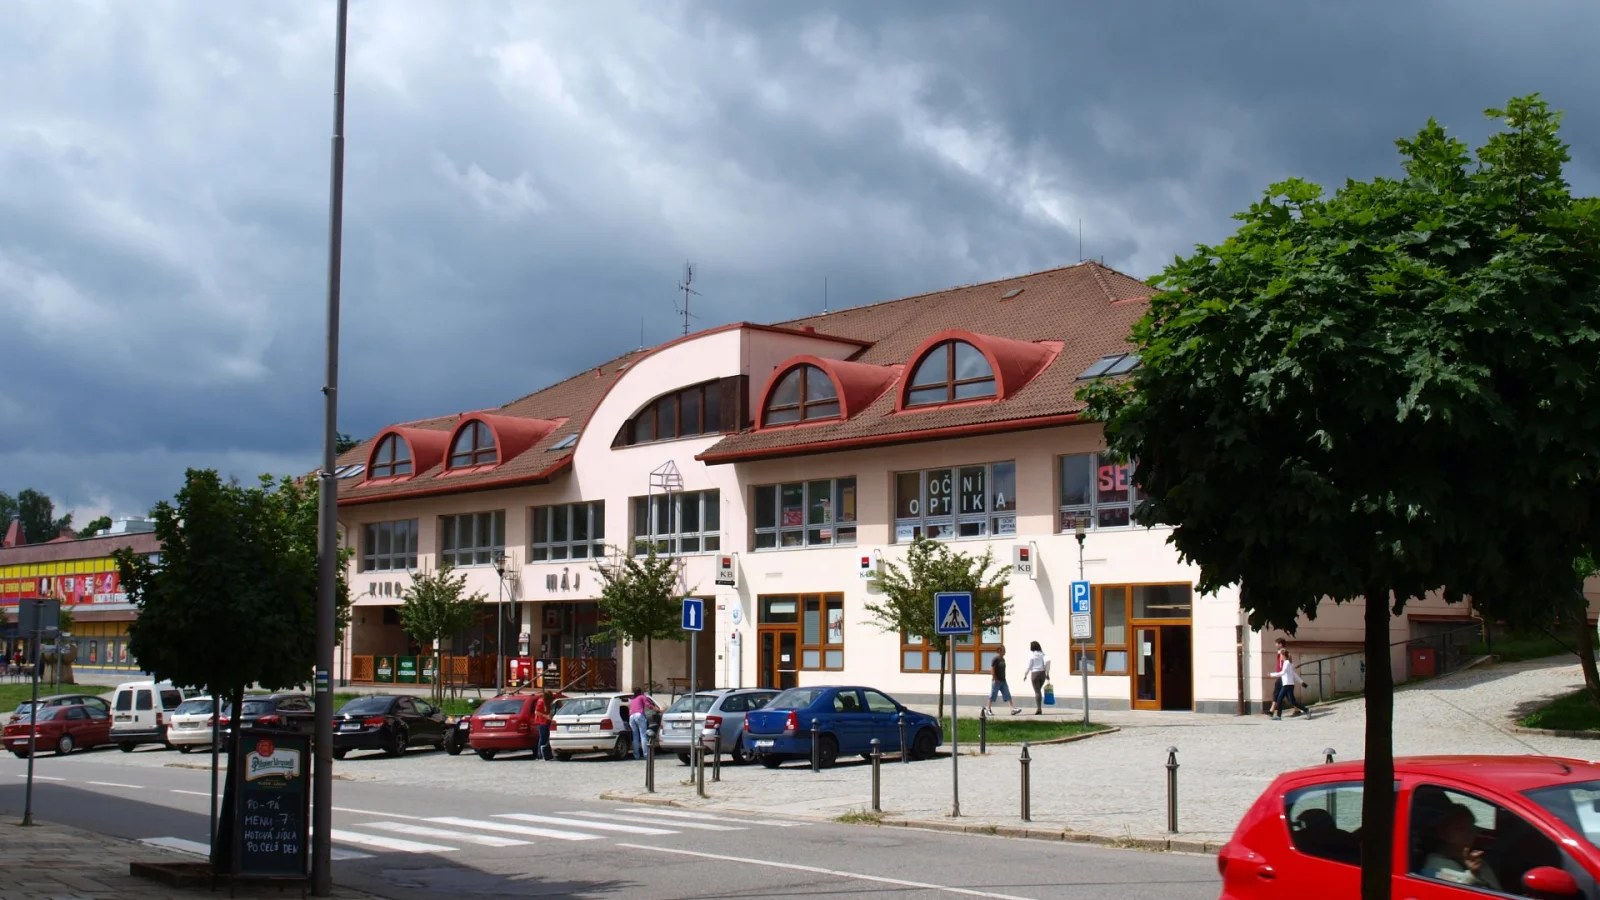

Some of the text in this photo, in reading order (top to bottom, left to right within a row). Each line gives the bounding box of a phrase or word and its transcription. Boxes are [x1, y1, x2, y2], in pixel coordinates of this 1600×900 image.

[929, 471, 982, 495] OČNÍ
[909, 491, 1007, 515] OPTIKA
[1017, 564, 1031, 572] KB
[369, 581, 403, 598] KINO
[1074, 584, 1086, 604] P
